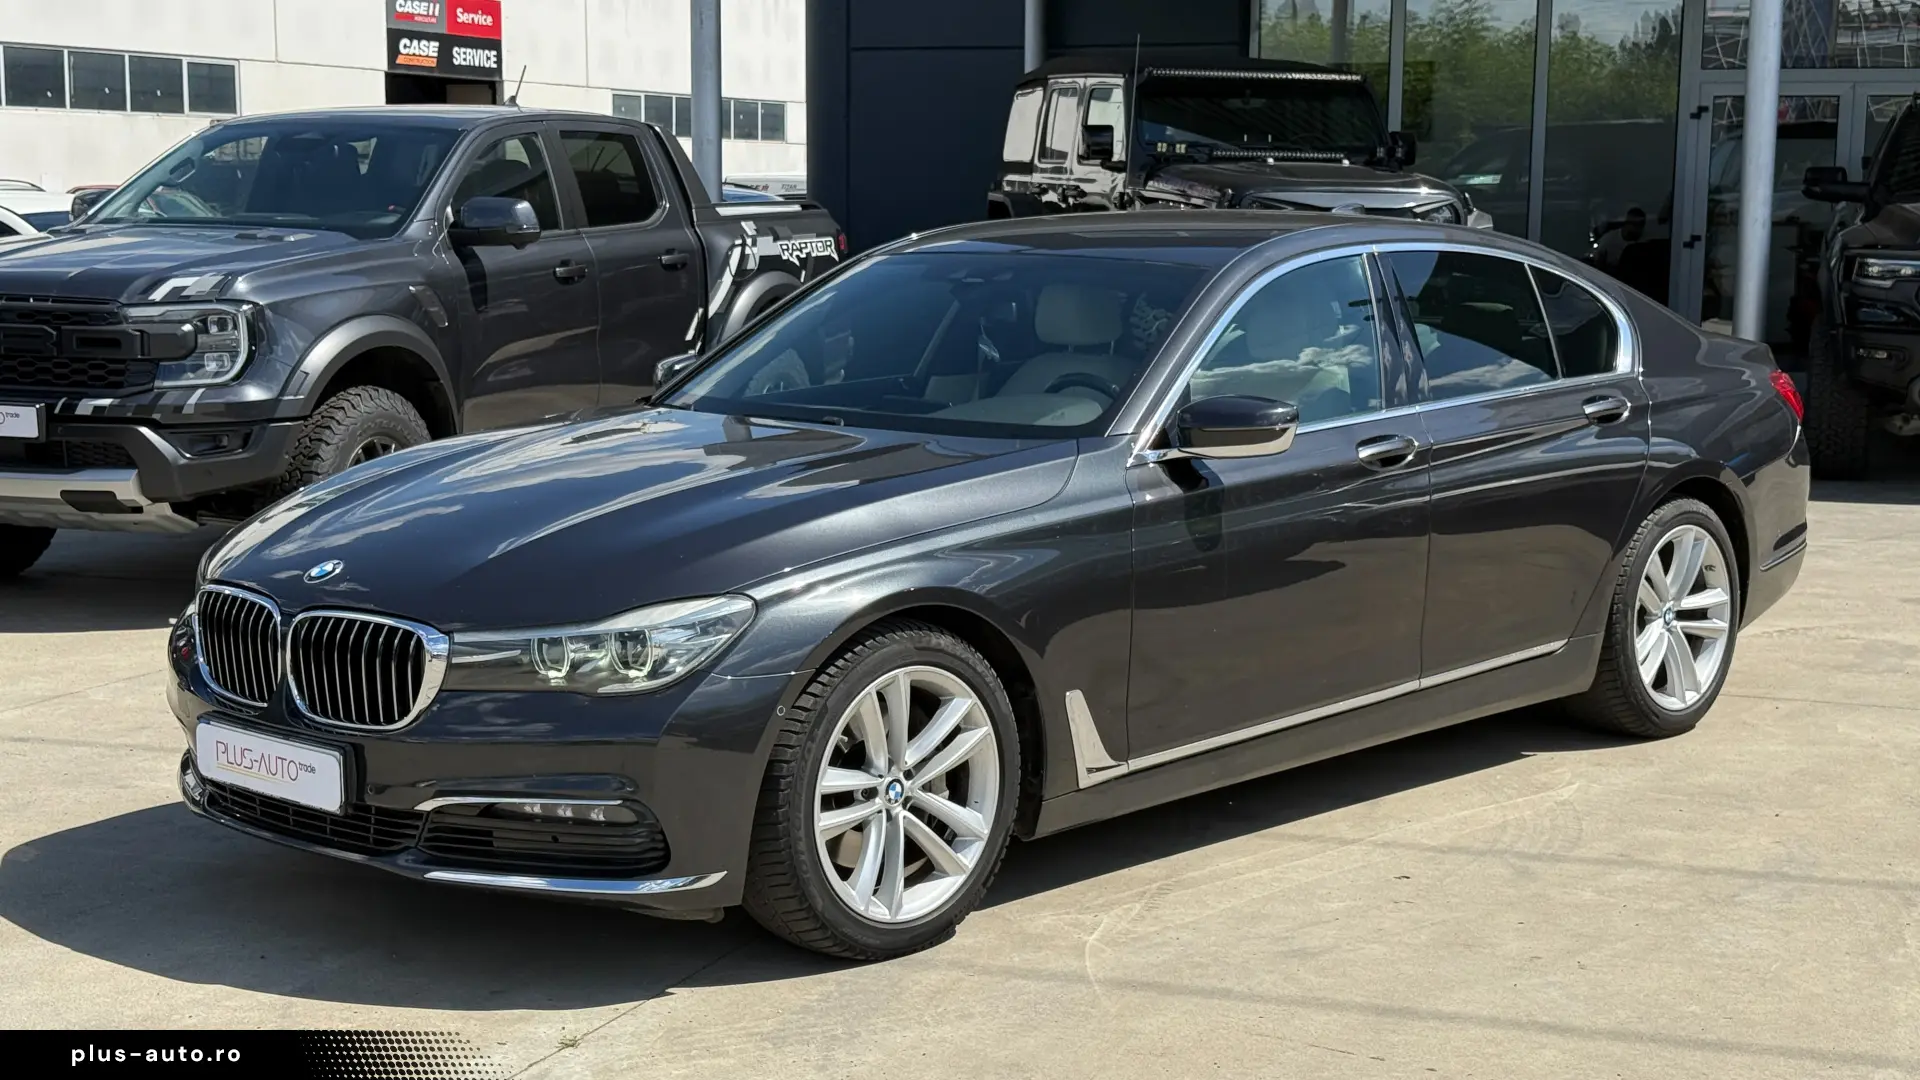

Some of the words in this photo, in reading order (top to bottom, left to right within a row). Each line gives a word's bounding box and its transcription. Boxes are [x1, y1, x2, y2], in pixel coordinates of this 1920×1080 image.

[456, 8, 493, 26] Service
[399, 38, 439, 57] CASE
[452, 46, 498, 68] SERVICE
[778, 237, 839, 265] RAPTOR
[215, 740, 299, 782] PLUS-AUTO
[299, 762, 317, 774] trade
